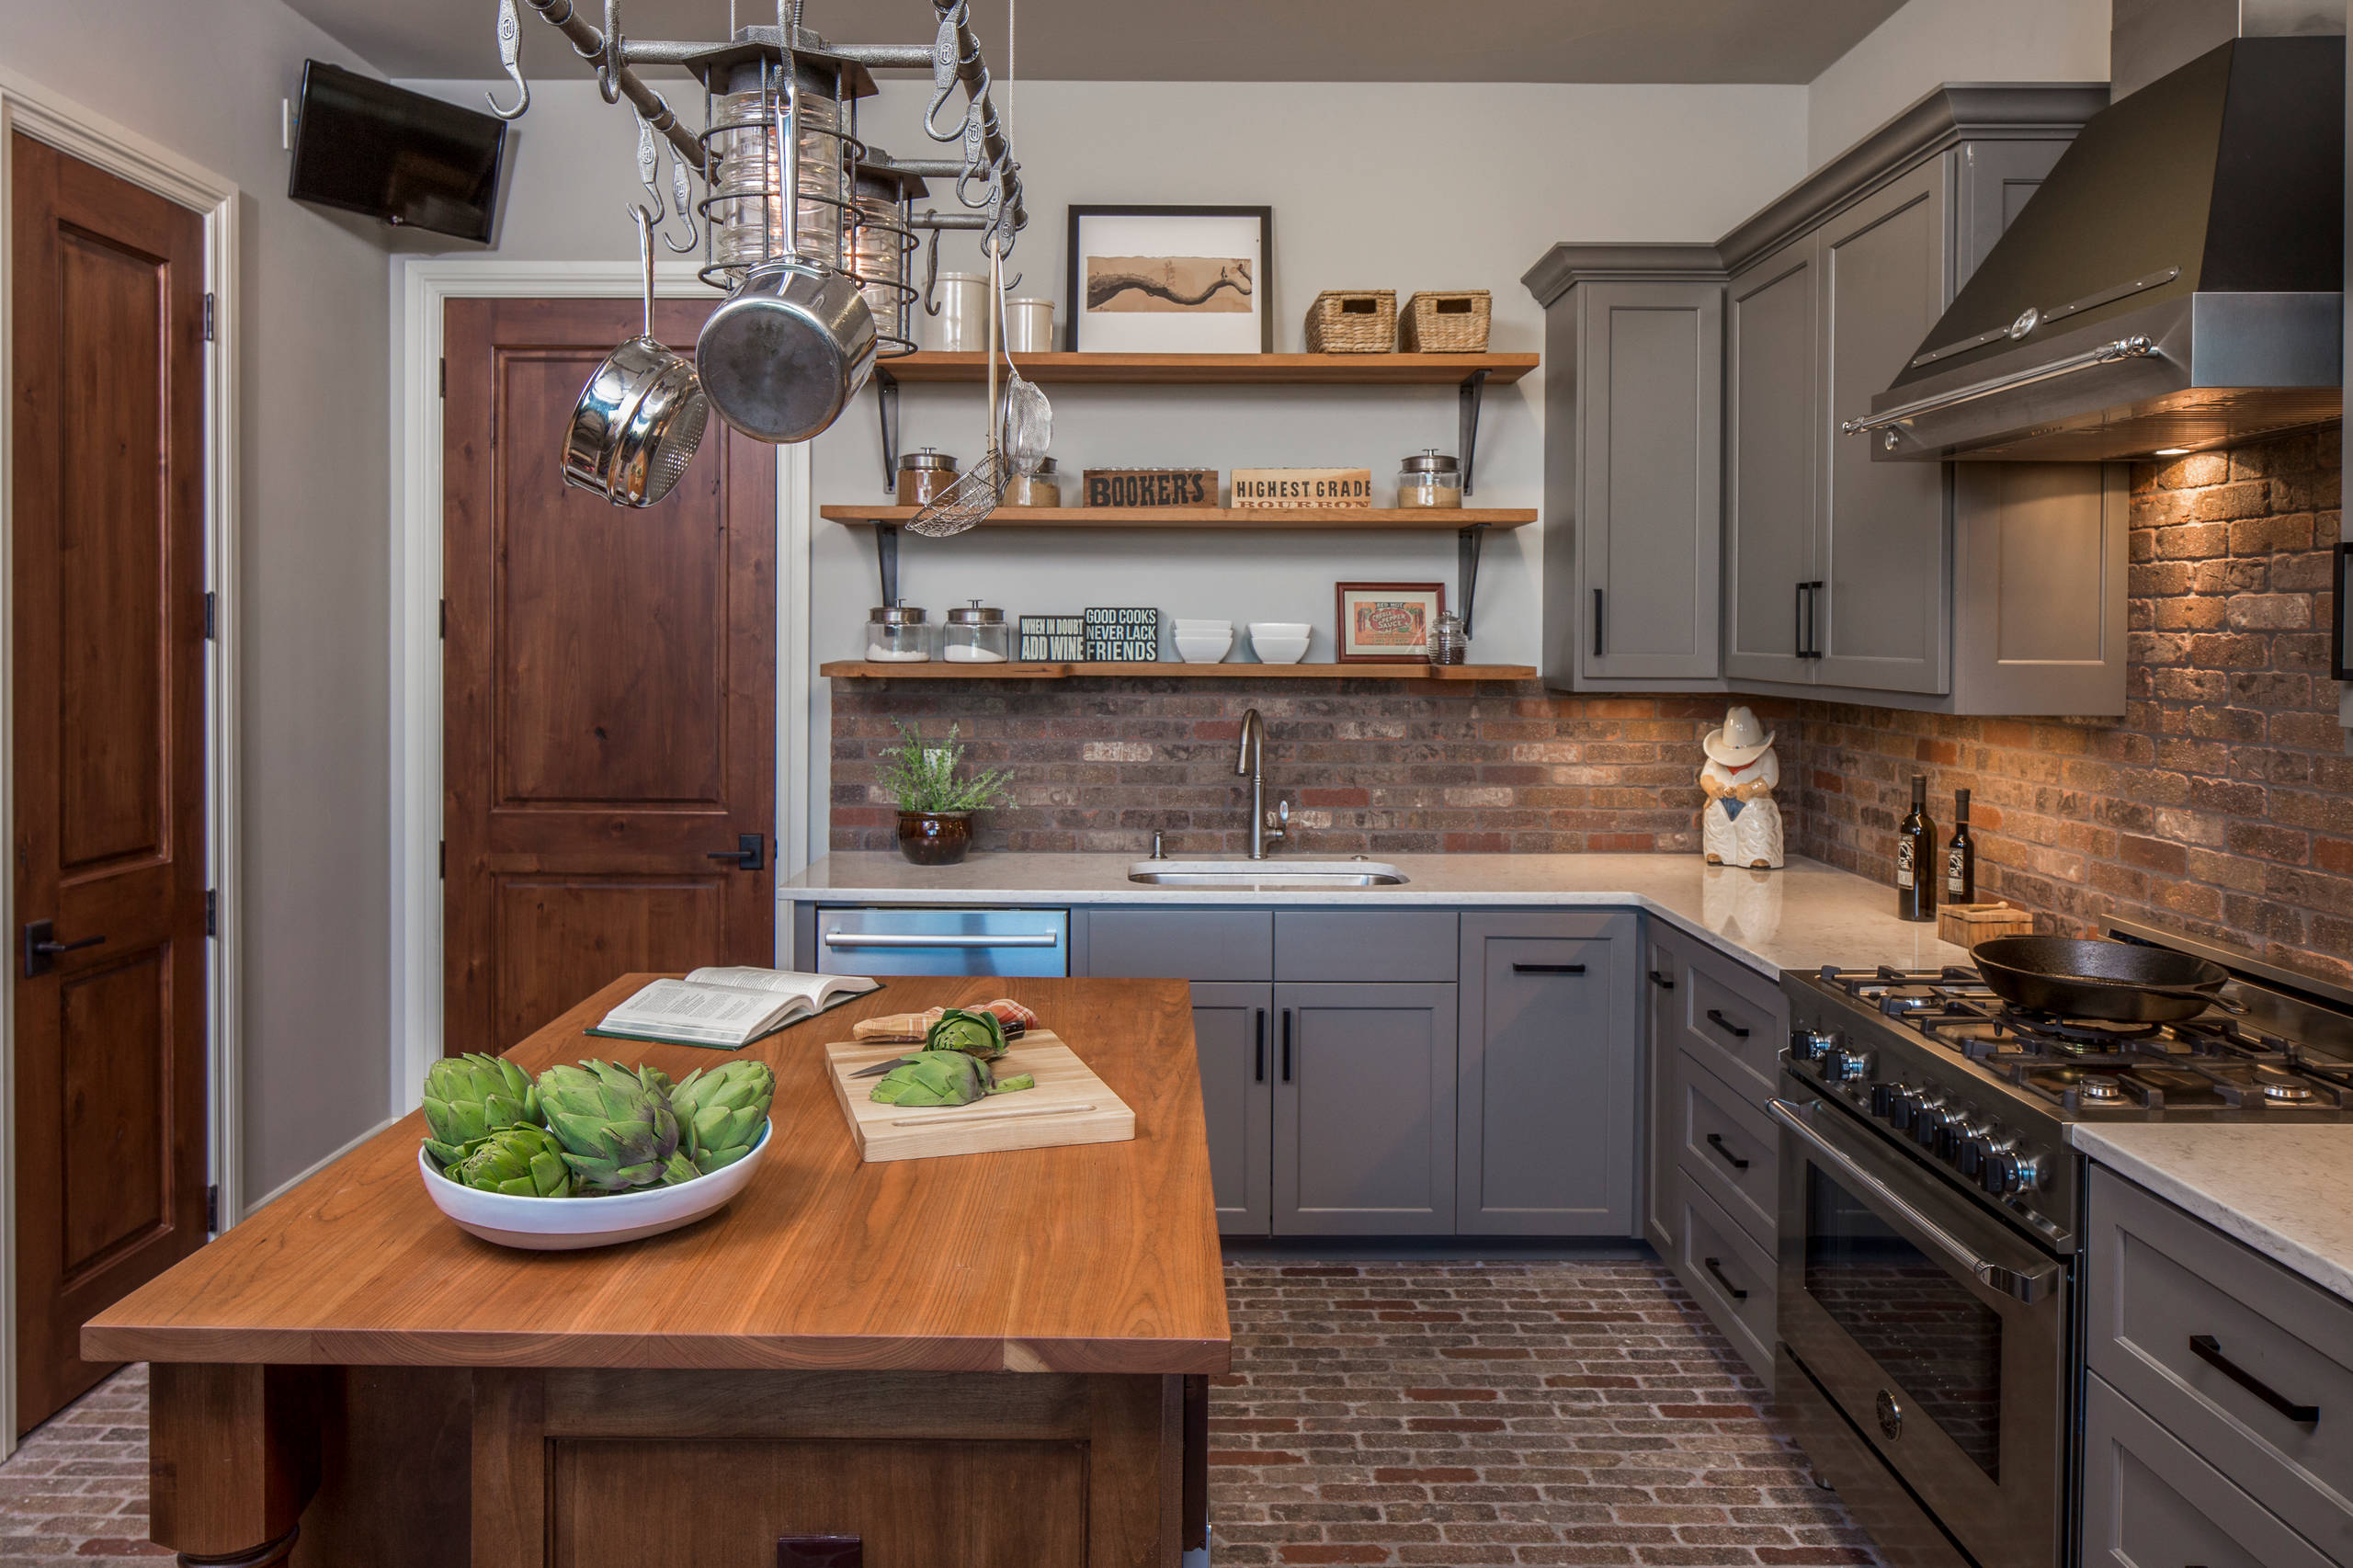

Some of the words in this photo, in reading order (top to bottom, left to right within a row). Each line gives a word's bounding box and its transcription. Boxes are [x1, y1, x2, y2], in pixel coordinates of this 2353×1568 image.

[1089, 472, 1205, 506] BOOKER'S
[1236, 481, 1311, 497] HIGHEST
[1316, 480, 1370, 497] GRADE
[1086, 609, 1116, 624] GOOD
[1119, 609, 1156, 624] COOKS
[1378, 620, 1403, 629] SAUCE
[1381, 614, 1406, 623] PEPPER
[1021, 618, 1045, 635] WHEN
[1046, 618, 1055, 635] IN
[1057, 618, 1084, 635] DOUBT
[1086, 625, 1124, 641] NEVER
[1126, 625, 1156, 641] LACK
[1021, 636, 1048, 661] ADD
[1050, 636, 1084, 661] WINE
[1086, 641, 1156, 661] FRIENDS
